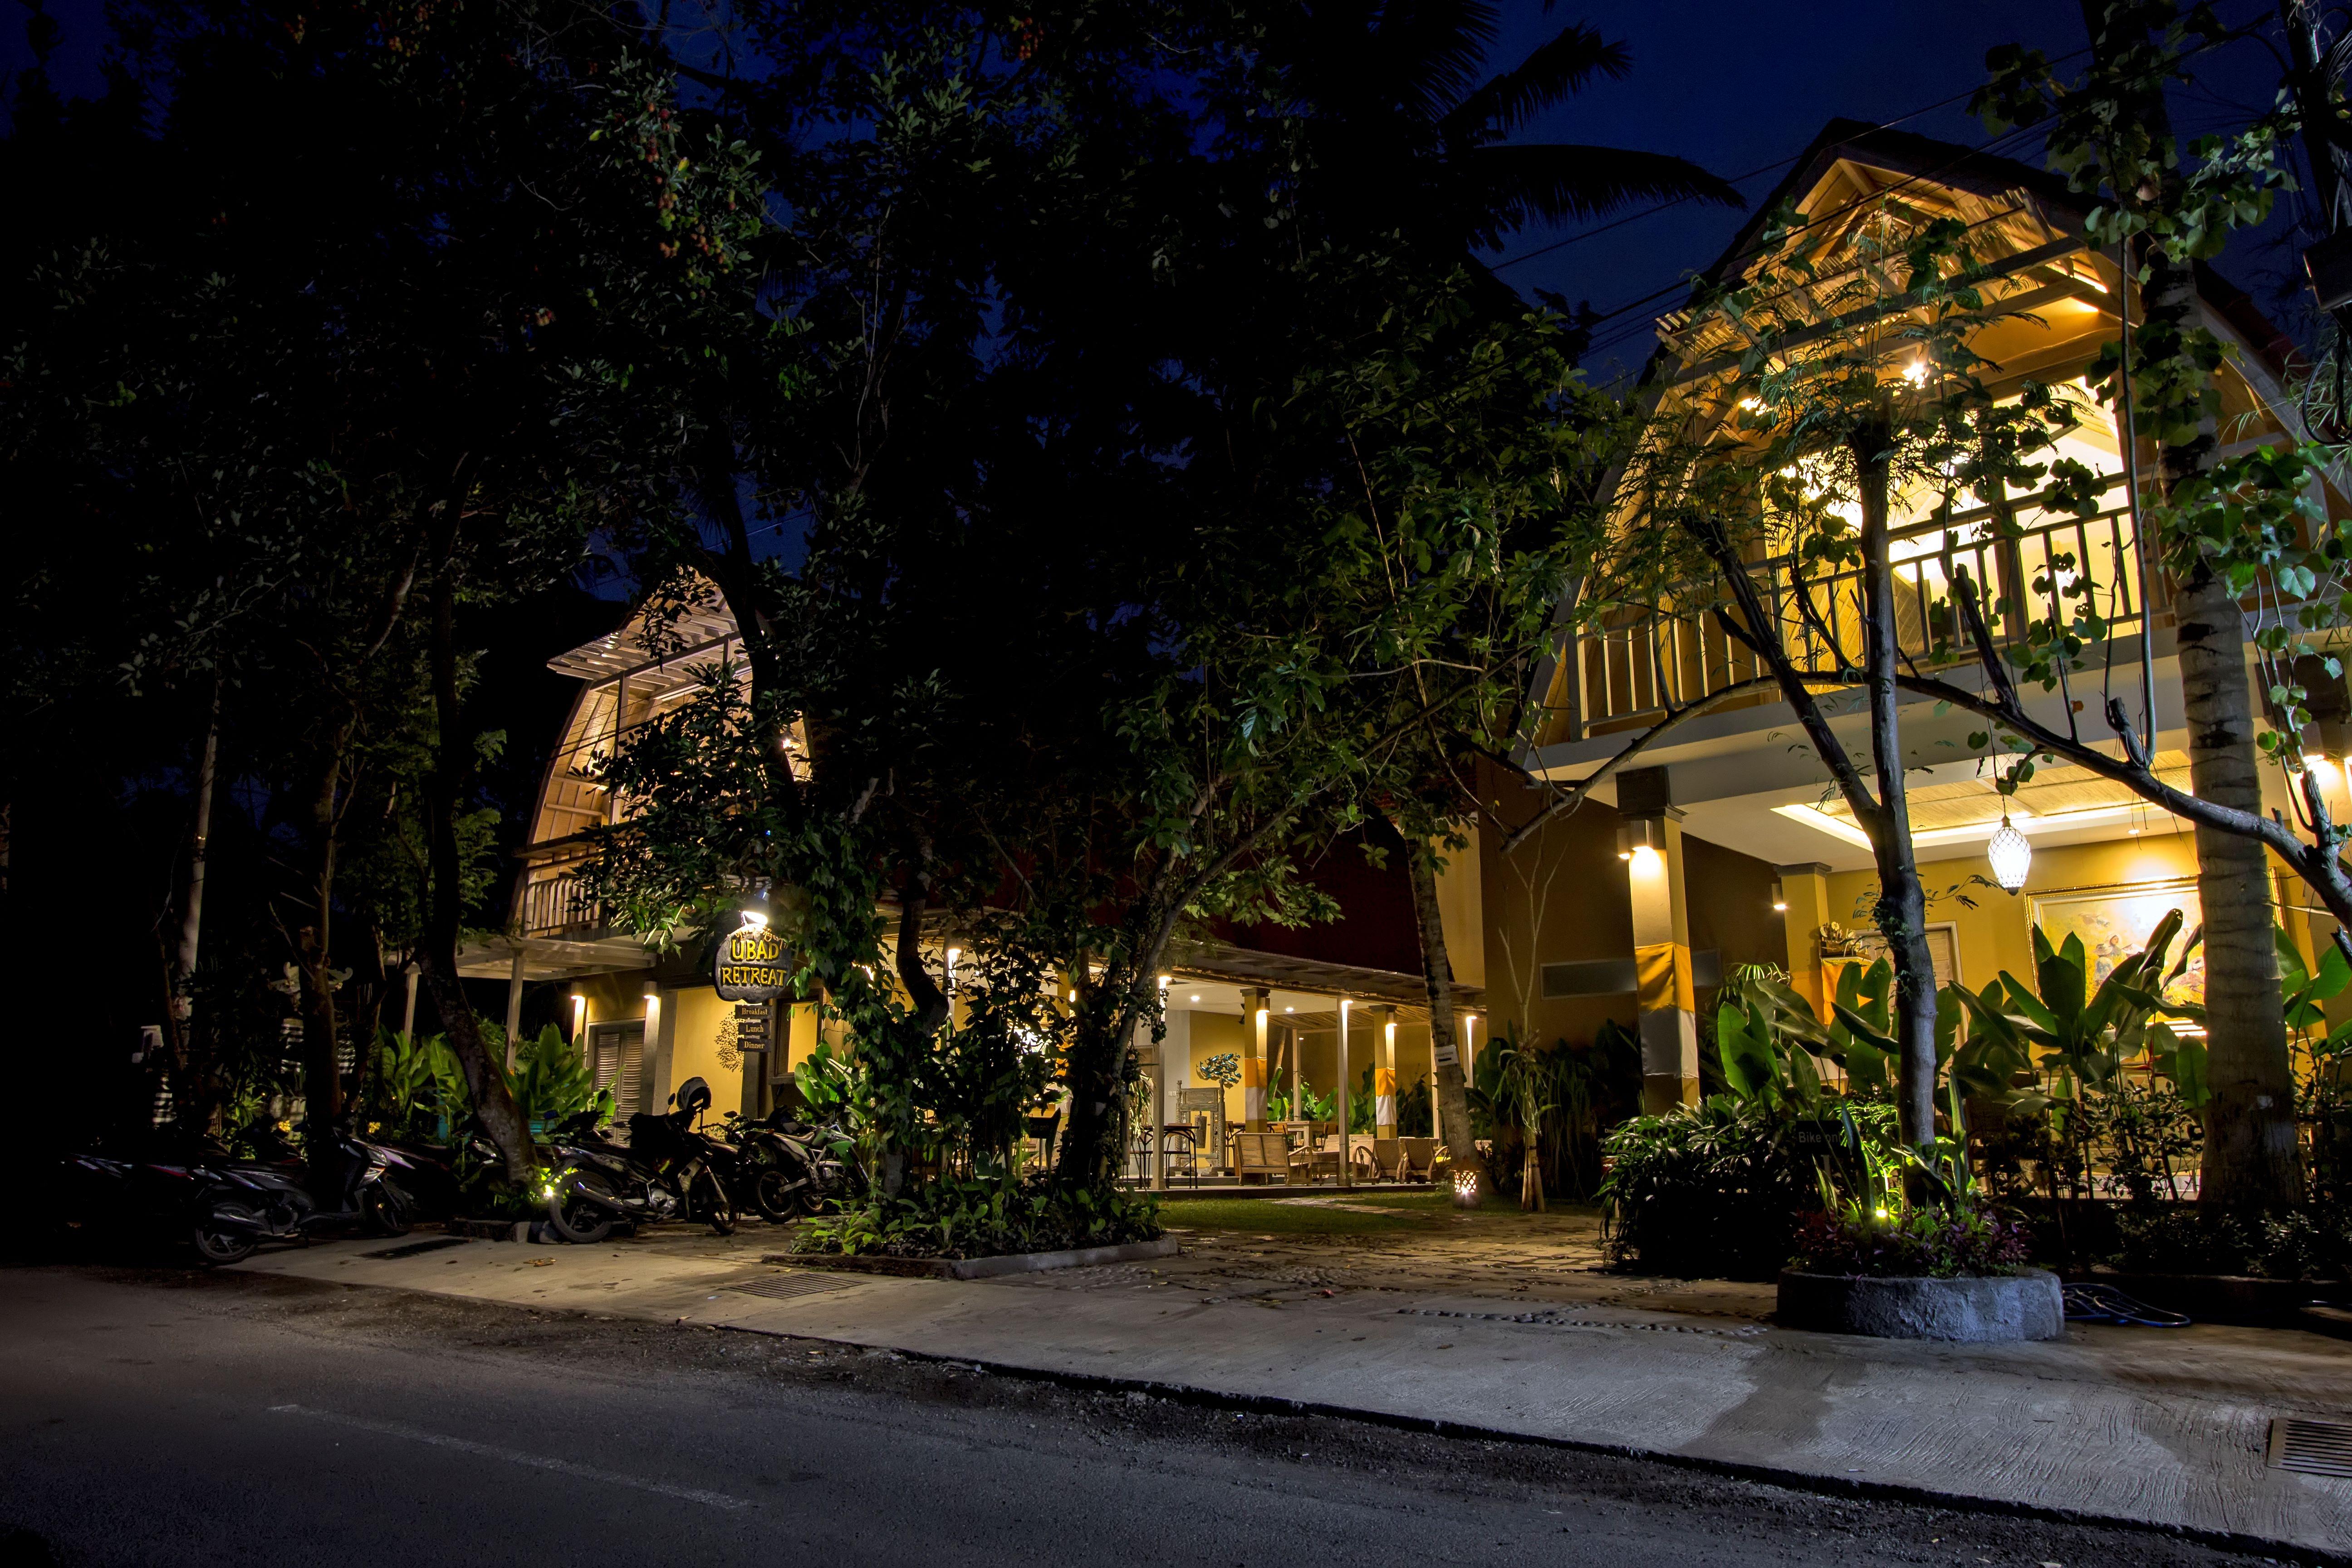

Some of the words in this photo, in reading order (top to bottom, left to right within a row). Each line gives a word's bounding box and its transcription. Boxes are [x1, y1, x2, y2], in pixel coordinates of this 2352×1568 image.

[731, 939, 779, 961] UBAD
[721, 966, 787, 986] RETREAT
[1798, 1131, 1822, 1143] Bike
